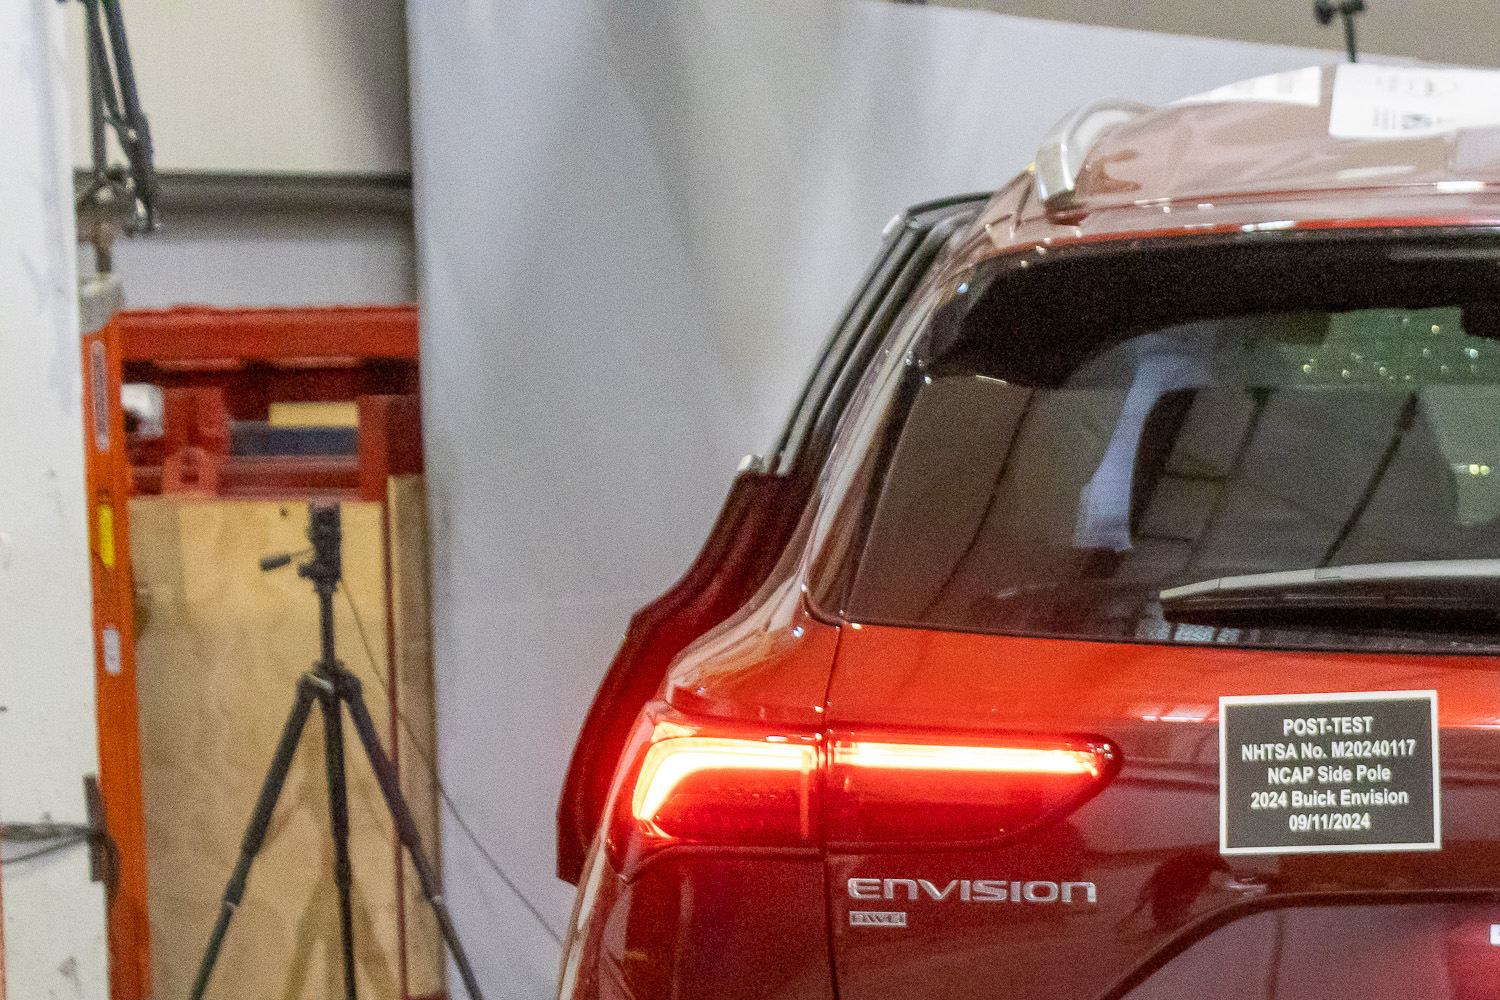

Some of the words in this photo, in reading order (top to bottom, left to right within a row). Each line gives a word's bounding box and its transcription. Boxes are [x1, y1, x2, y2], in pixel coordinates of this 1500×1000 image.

[1283, 716, 1373, 736] POST-TEST
[1242, 743, 1298, 761] NHTSA
[1301, 742, 1327, 759] No.
[1331, 739, 1416, 758] M20240117
[1267, 766, 1313, 784] NCAP
[1318, 765, 1352, 782] Side
[1356, 764, 1391, 781] Pole
[1251, 791, 1287, 809] 2024
[1292, 790, 1336, 807] Buick
[1340, 788, 1409, 806] Envision
[1289, 813, 1371, 832] 09/11/2024
[847, 877, 1096, 903] ENVISION
